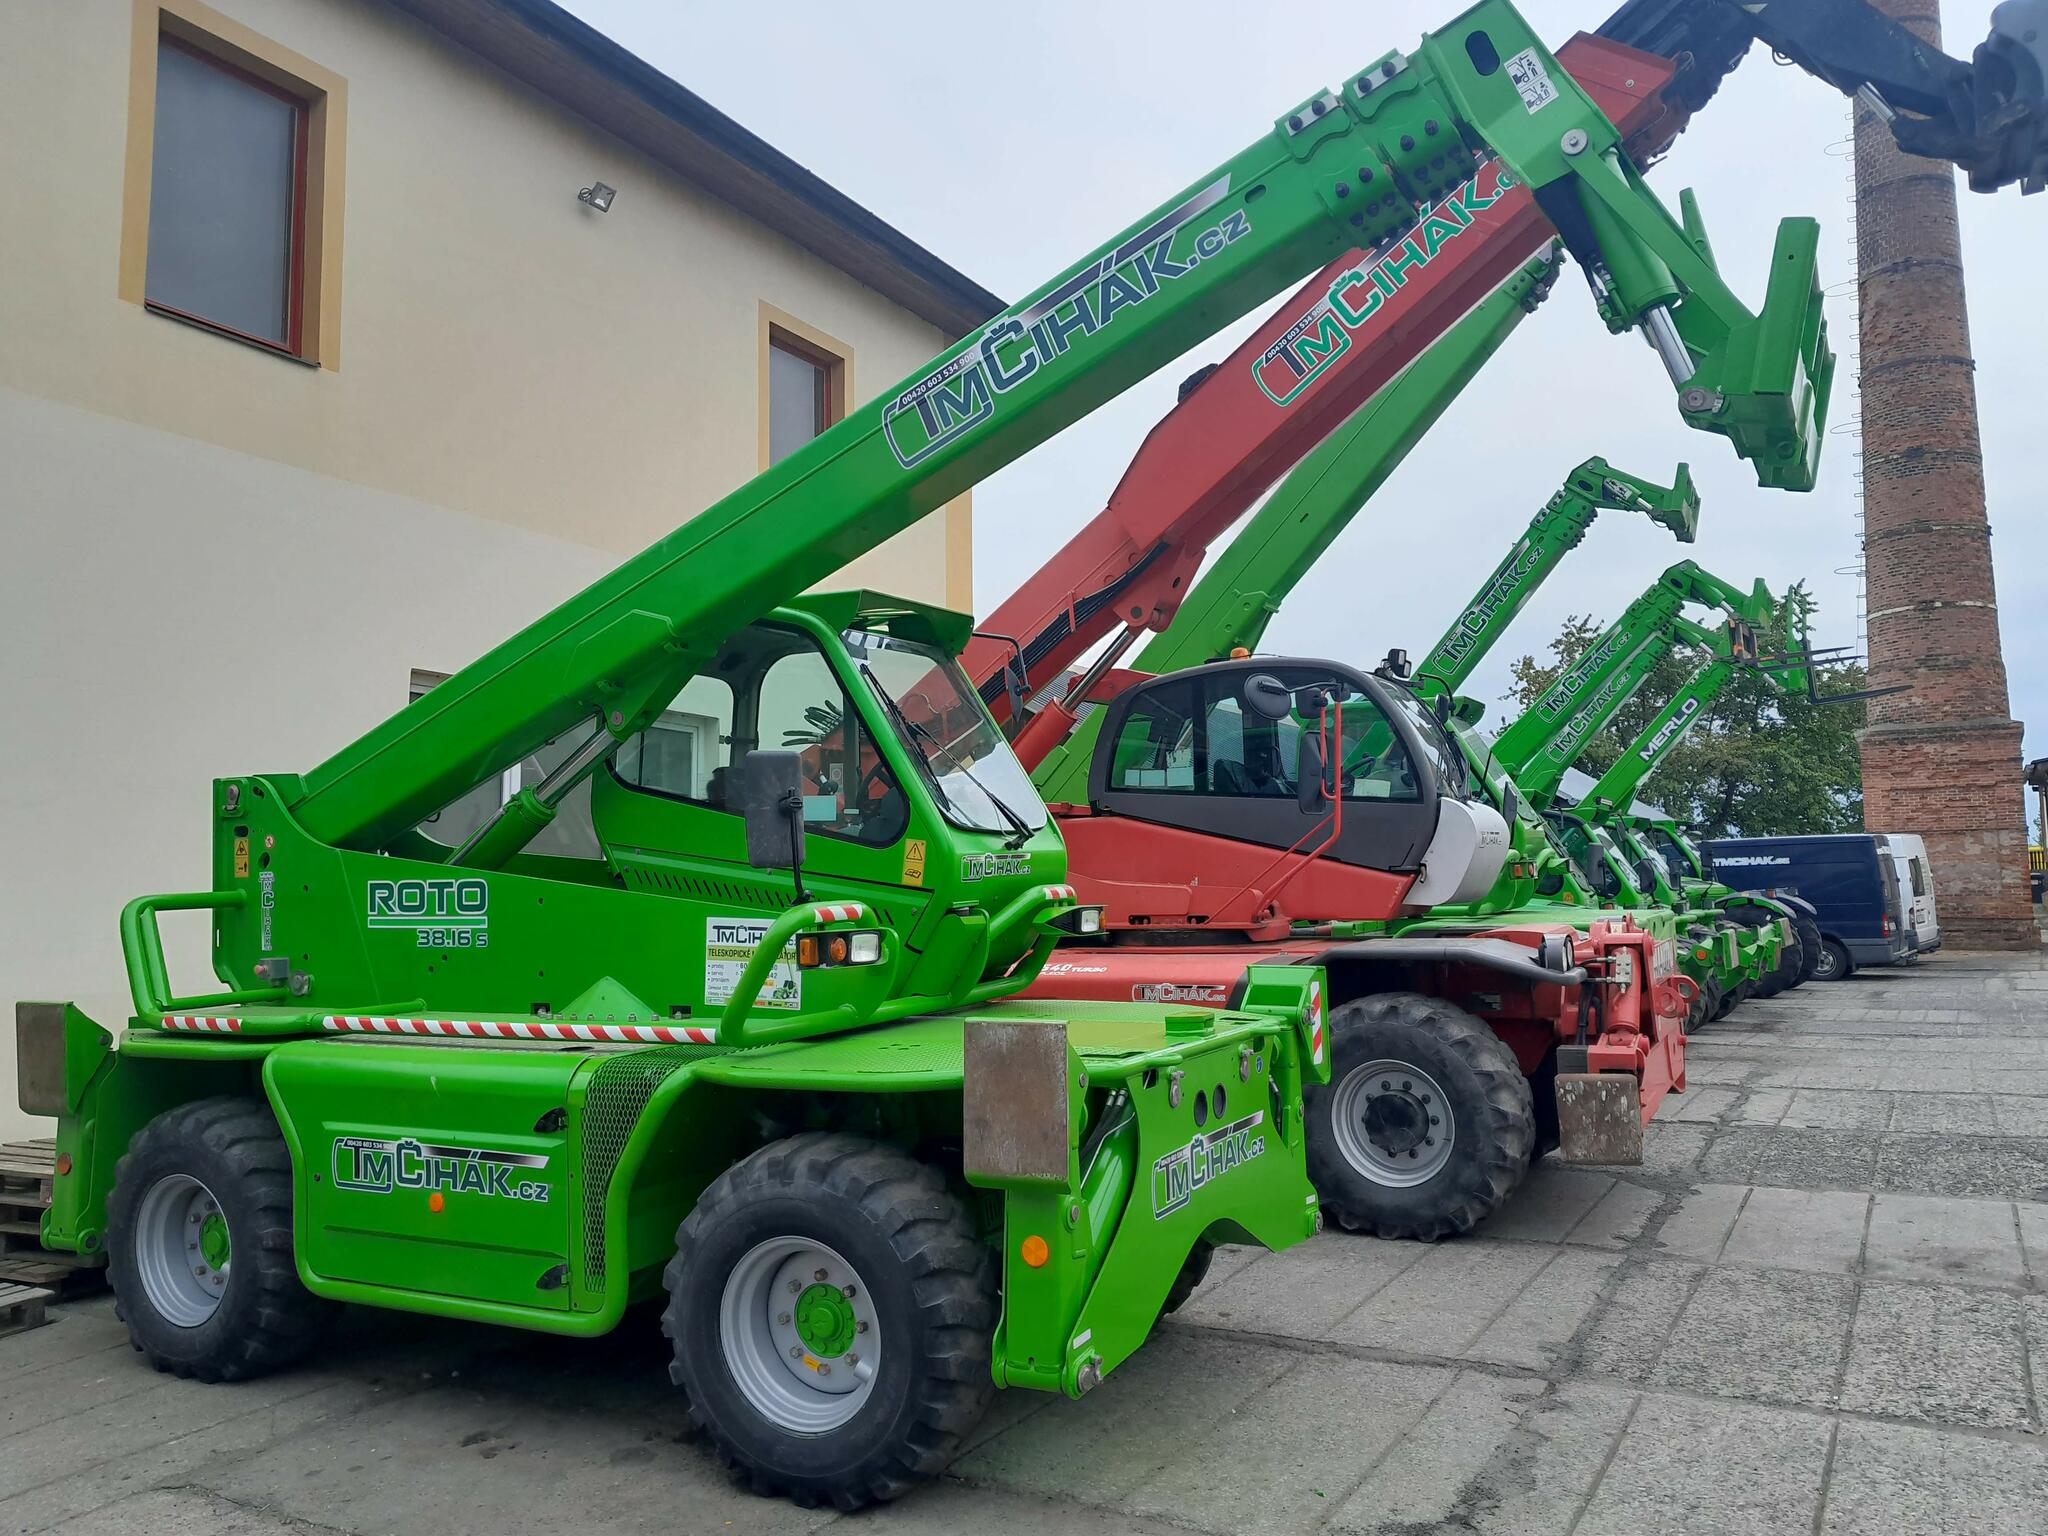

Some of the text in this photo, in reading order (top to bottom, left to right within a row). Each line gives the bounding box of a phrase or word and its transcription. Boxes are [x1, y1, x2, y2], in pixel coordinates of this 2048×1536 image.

[1264, 171, 1517, 379] TMČIHÁK.c
[1267, 339, 1288, 358] 00420
[1287, 327, 1300, 340] 603
[1299, 315, 1312, 329] 534
[902, 352, 975, 405] 00420 603 534 900
[1640, 698, 1698, 760] MERLO
[368, 879, 488, 915] ROTO
[417, 929, 471, 947] 38.16
